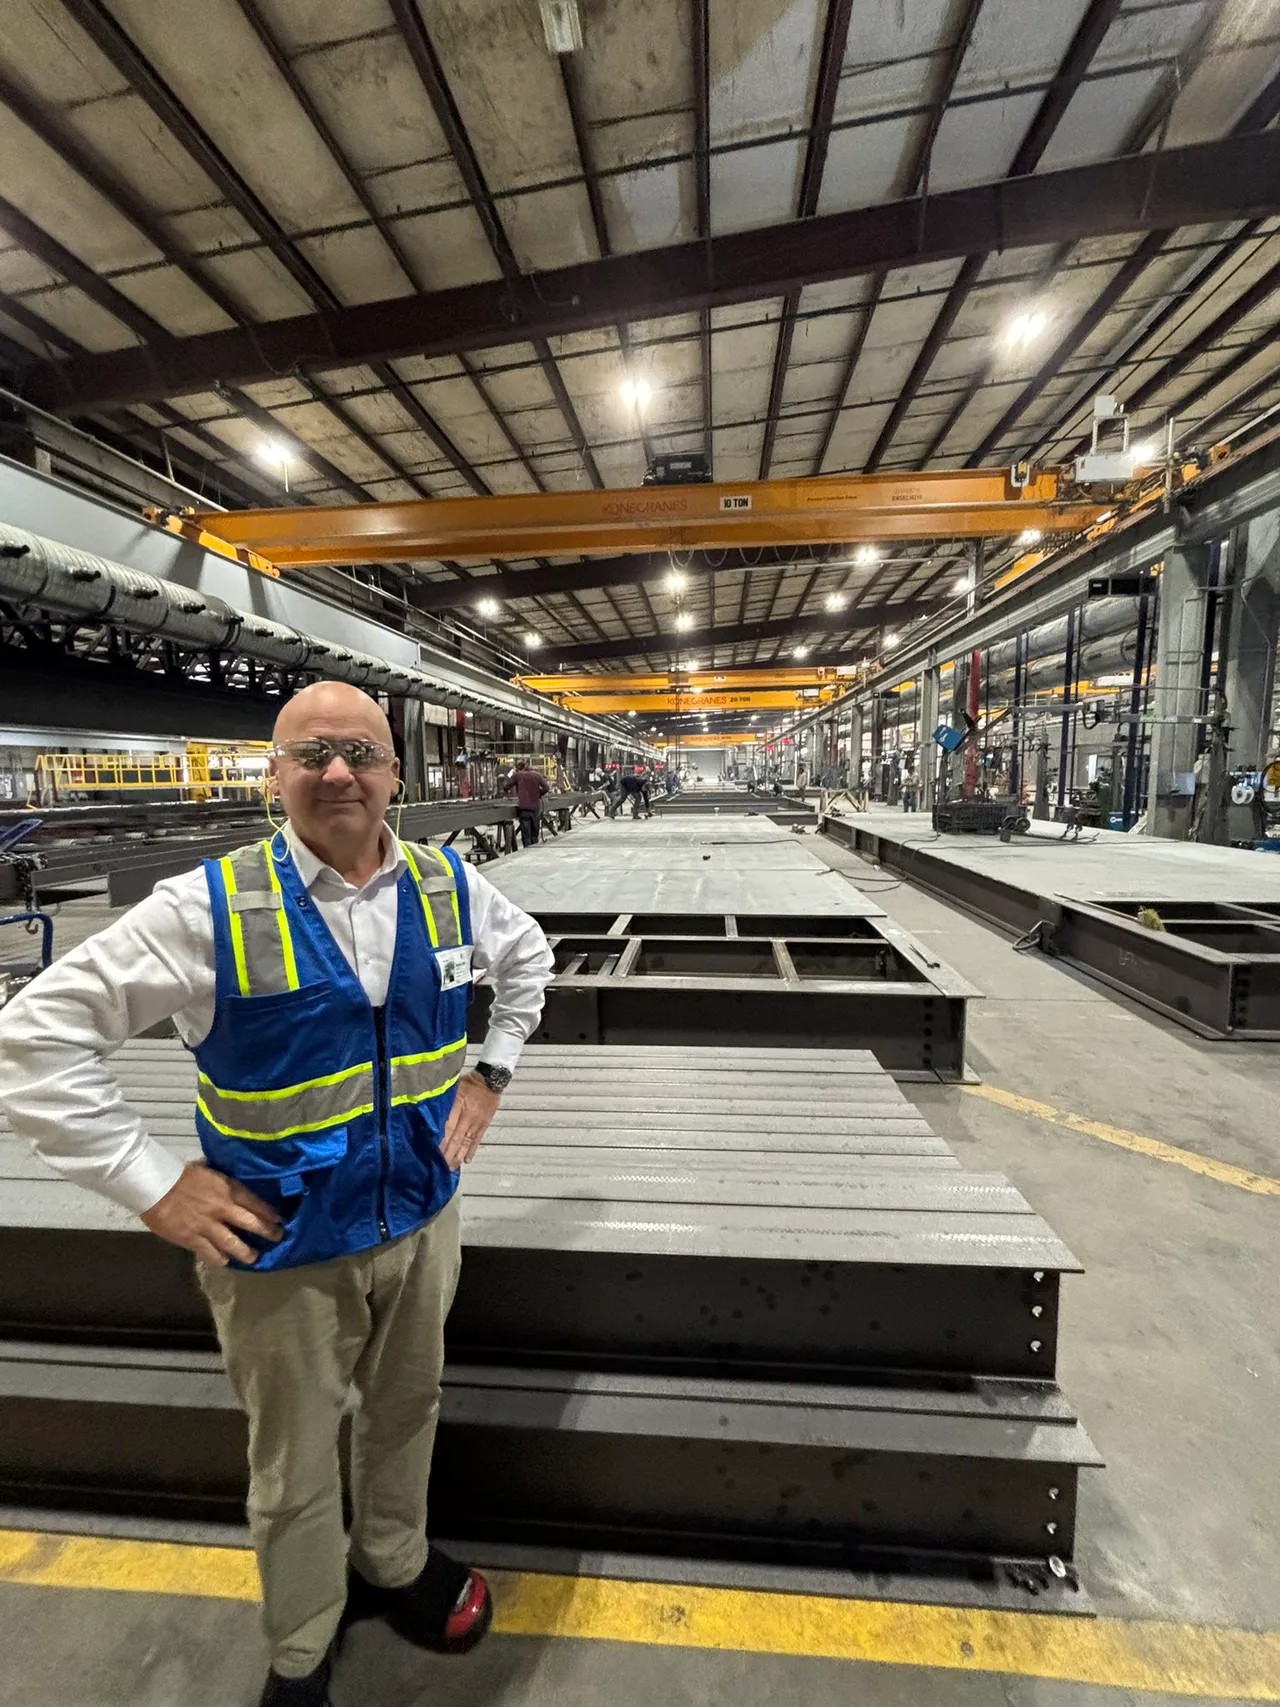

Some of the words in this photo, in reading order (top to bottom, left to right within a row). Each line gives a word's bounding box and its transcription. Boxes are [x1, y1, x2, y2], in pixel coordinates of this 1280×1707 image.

[724, 499, 731, 508] 10
[733, 498, 748, 507] TON
[667, 696, 727, 705] KONECRANES
